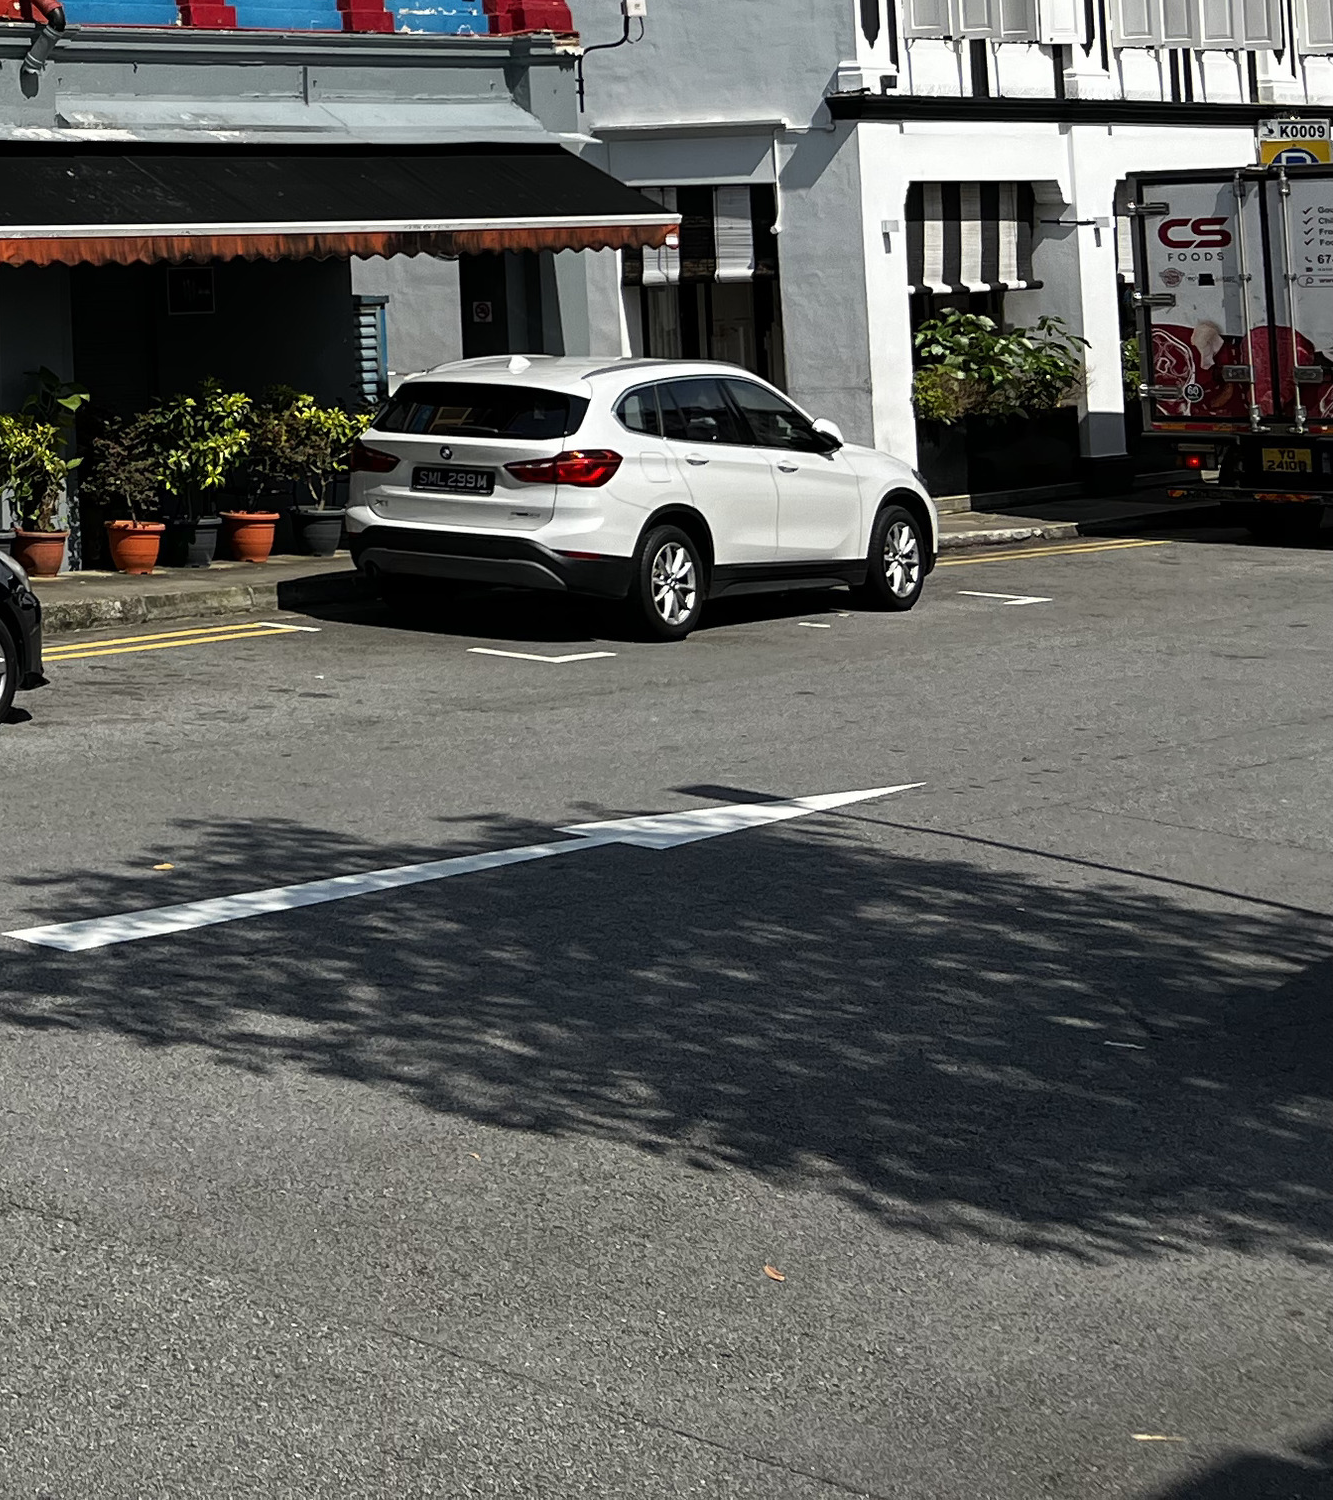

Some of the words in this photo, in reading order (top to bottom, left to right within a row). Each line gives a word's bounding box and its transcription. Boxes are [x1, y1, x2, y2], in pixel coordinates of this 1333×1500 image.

[1279, 125, 1325, 138] K0009
[1158, 216, 1233, 250] CS
[1167, 252, 1225, 262] FOODS
[1317, 254, 1333, 264] 67
